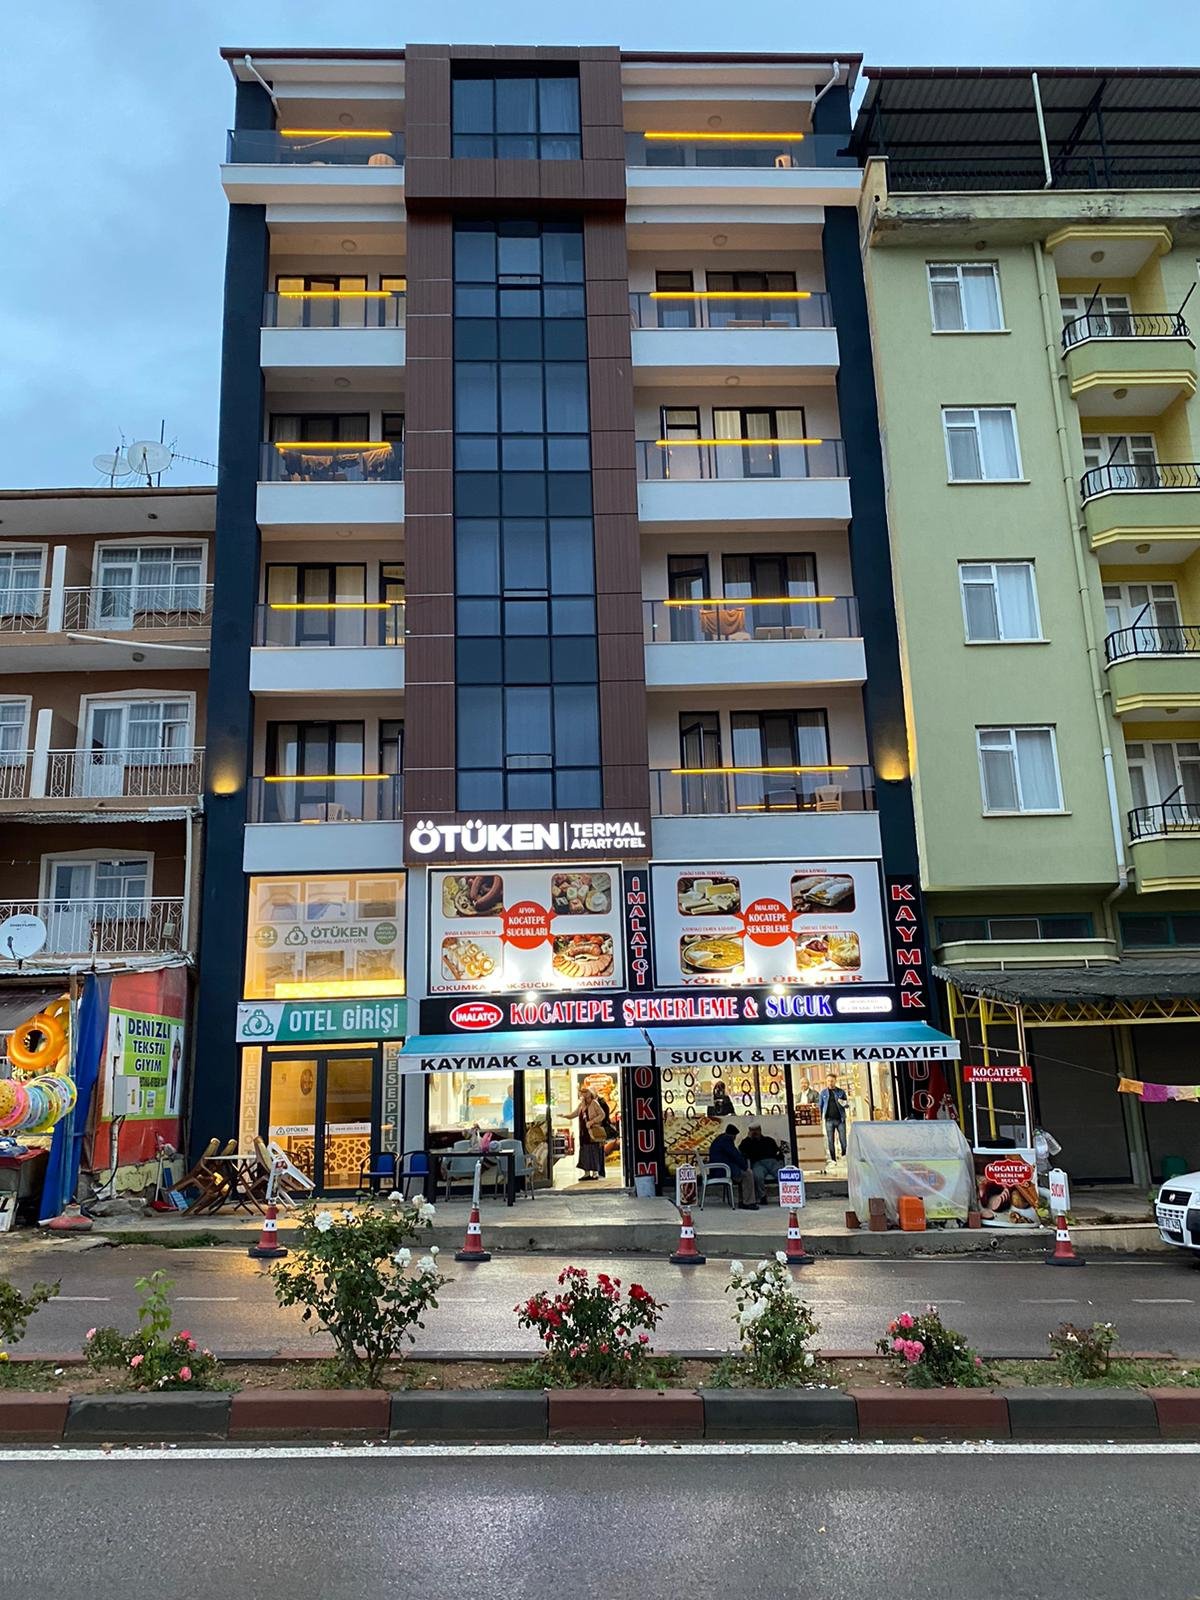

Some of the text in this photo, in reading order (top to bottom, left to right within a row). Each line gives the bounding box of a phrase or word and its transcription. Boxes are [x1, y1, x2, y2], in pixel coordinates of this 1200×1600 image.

[409, 819, 559, 854] ÖTÜKEN
[570, 822, 645, 838] TERMAL
[570, 838, 645, 850] APART OTEL
[508, 916, 546, 925] KOCATEPE
[748, 913, 787, 922] KOCATEPE
[310, 926, 368, 939] ÖTÜKEN
[506, 927, 548, 937] SUCUKLARI
[627, 876, 649, 985] İMALATÇI
[746, 925, 791, 936] ŞEKERLEME
[891, 884, 926, 1008] KAYMAK
[681, 976, 768, 985] YÖREL
[510, 995, 833, 1026] KOCATEPE ŞEKERLEME & SUCUK
[289, 1003, 399, 1033] OTEL GİRİŞİ
[455, 1011, 497, 1024] İMALATÇI
[421, 1052, 631, 1071] KAYMAK & LOKUM
[671, 1046, 948, 1064] SUCUK & EKMEK KADAYIFI
[972, 1067, 1023, 1077] KOCATEPE
